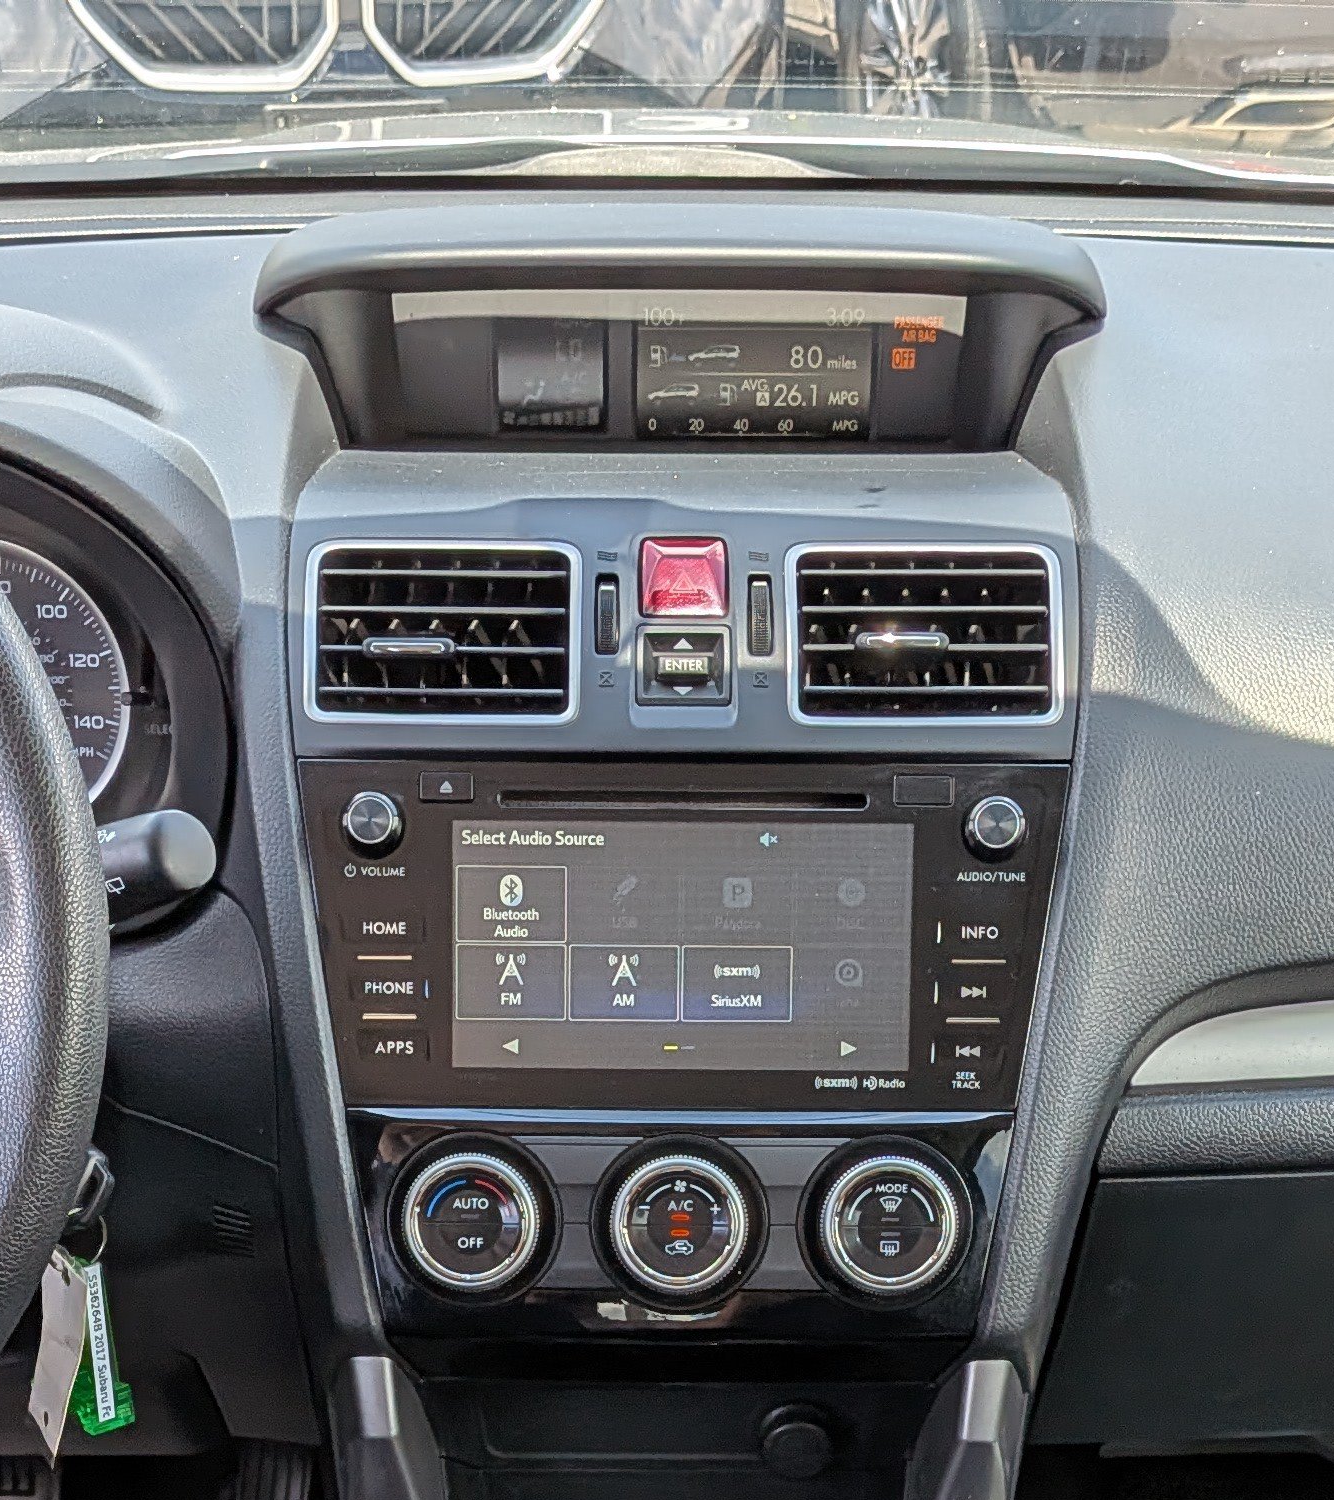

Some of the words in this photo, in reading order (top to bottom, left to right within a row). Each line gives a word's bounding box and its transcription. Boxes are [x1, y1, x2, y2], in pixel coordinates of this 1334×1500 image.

[789, 345, 823, 370] 80
[827, 354, 857, 370] miles
[893, 350, 915, 367] OFF
[773, 384, 818, 408] 26.1
[827, 390, 860, 407] MPG
[648, 418, 657, 431] 0
[689, 418, 705, 431] 20
[733, 418, 750, 431] 40
[777, 418, 794, 432] 60
[831, 419, 859, 432] MPG
[35, 604, 68, 619] 100
[68, 653, 100, 668] 120
[664, 659, 704, 671] ENTER
[73, 715, 105, 730] 140
[461, 829, 506, 846] Select
[508, 829, 552, 846] Audio
[554, 830, 605, 847] Source
[360, 866, 406, 877] VOLUME
[956, 871, 1026, 883] AUDIO/TUNE
[482, 907, 540, 921] Bluetooth
[362, 921, 407, 935] HOME
[493, 925, 529, 938] Audio
[961, 926, 999, 940] INFO
[364, 982, 414, 995] PHONE
[500, 993, 522, 1006] FM
[612, 994, 635, 1007] AM
[710, 994, 762, 1008] SiriusXM
[374, 1041, 415, 1055] APPS
[955, 1071, 977, 1080] SEEK
[878, 1078, 906, 1089] Radio
[951, 1080, 981, 1090] TRACK
[874, 1183, 909, 1195] MODE
[452, 1197, 489, 1210] AUTO
[667, 1199, 694, 1214] A/C
[457, 1236, 484, 1250] OFF
[94, 1333, 107, 1361] 2017
[97, 1363, 110, 1404] Subaru
